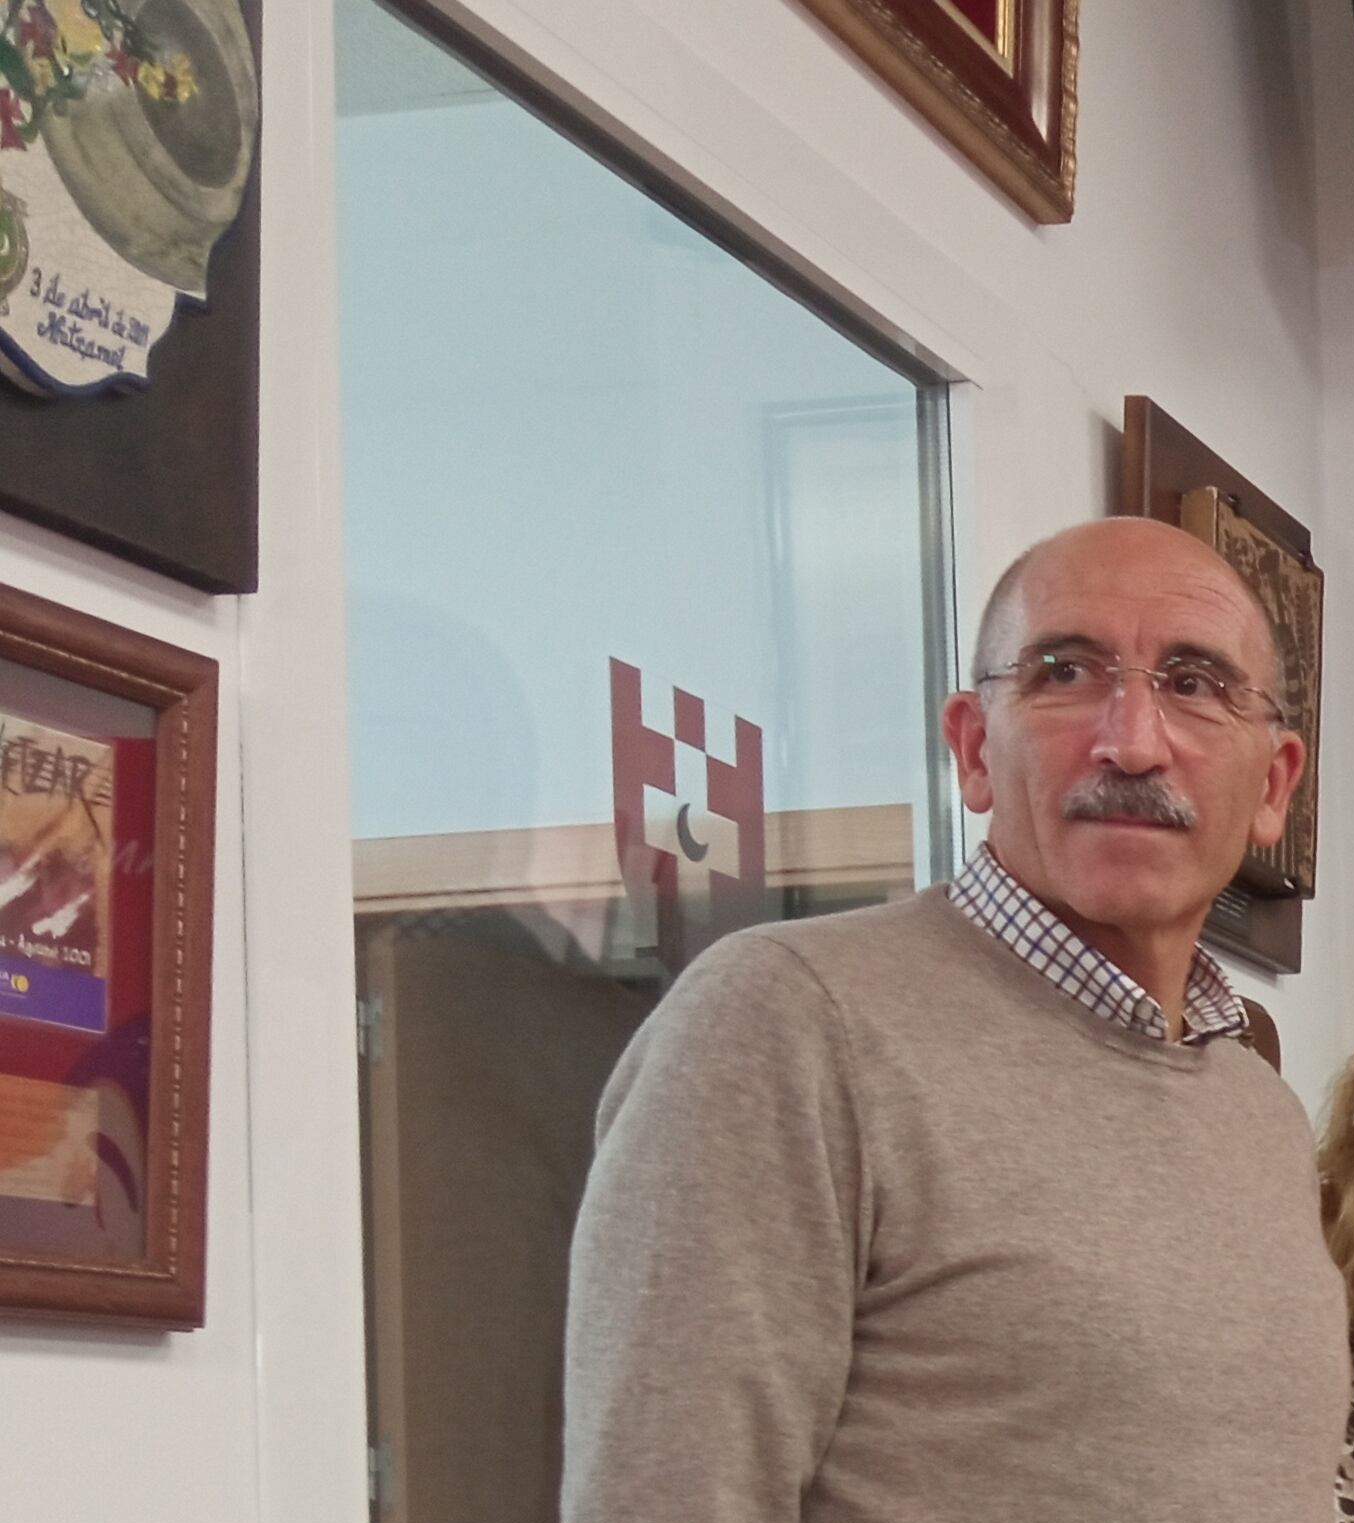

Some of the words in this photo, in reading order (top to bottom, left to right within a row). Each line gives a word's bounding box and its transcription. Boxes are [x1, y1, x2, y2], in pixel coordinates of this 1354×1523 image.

[30, 267, 42, 297] 3
[43, 273, 66, 308] de
[67, 288, 112, 329] abril
